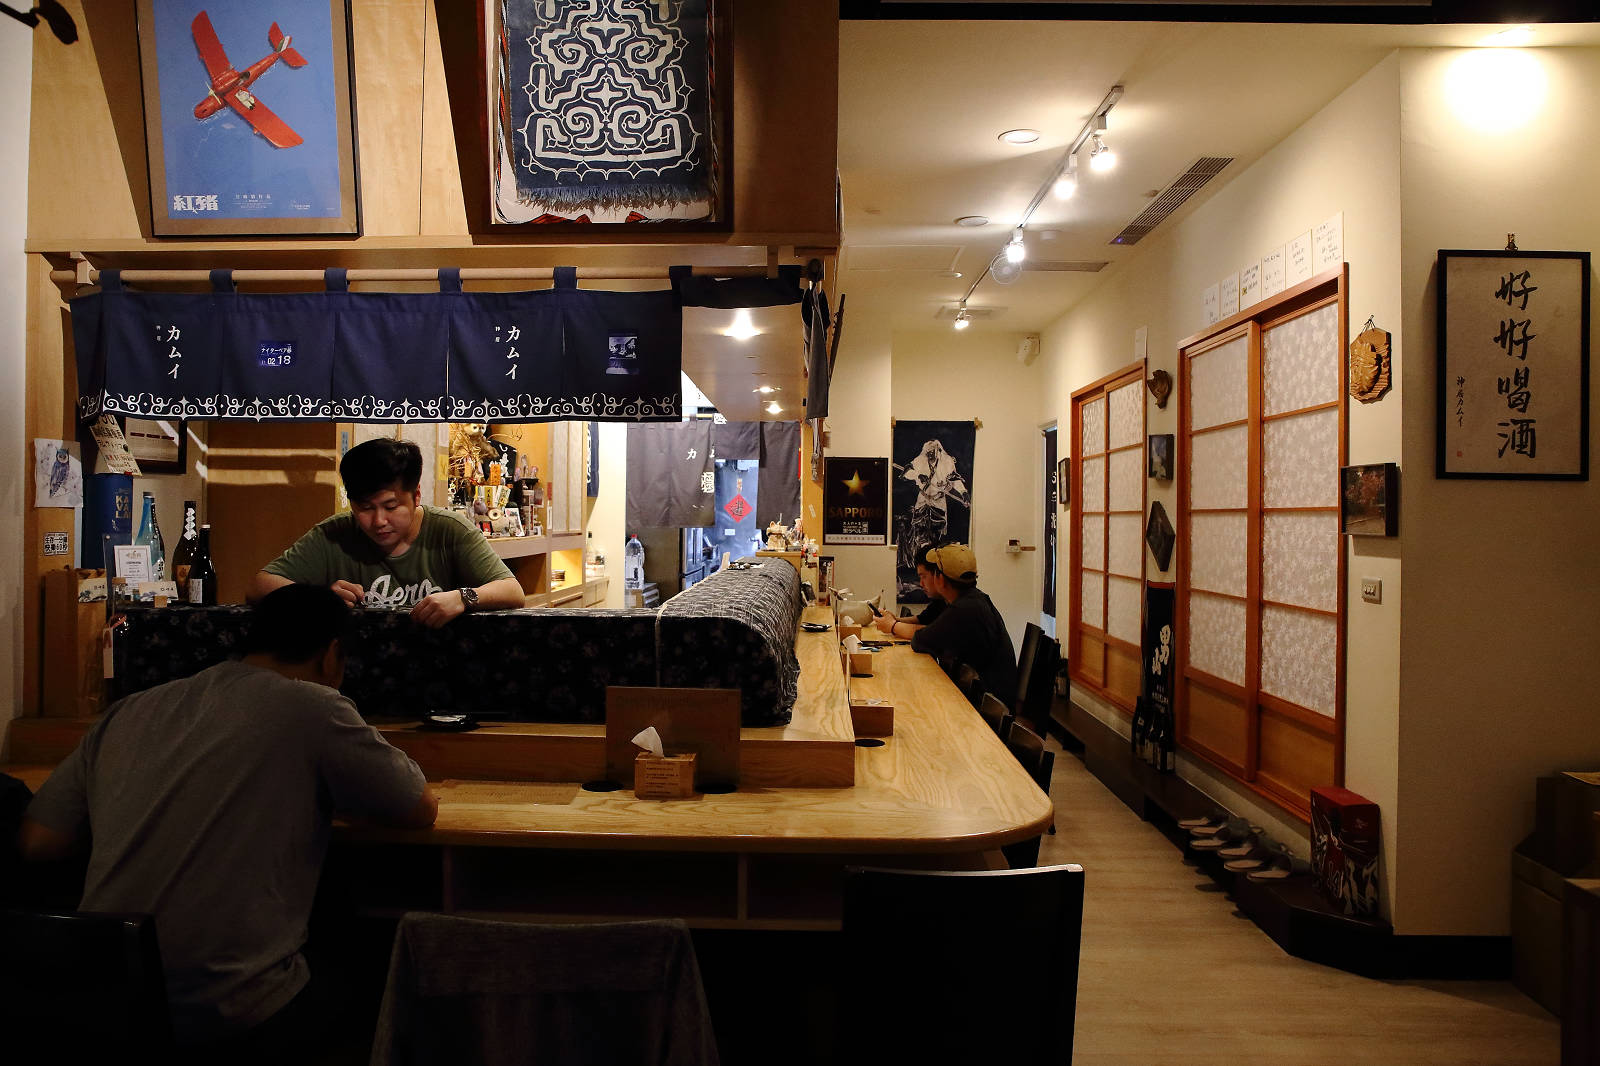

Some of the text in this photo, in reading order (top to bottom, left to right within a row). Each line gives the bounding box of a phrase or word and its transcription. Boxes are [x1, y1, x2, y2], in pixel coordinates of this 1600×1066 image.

[166, 325, 182, 379] カムイ
[277, 355, 292, 365] 18
[505, 325, 521, 380] カムイ
[1493, 270, 1538, 459] 好好喝酒
[829, 508, 883, 518] SAPPORO
